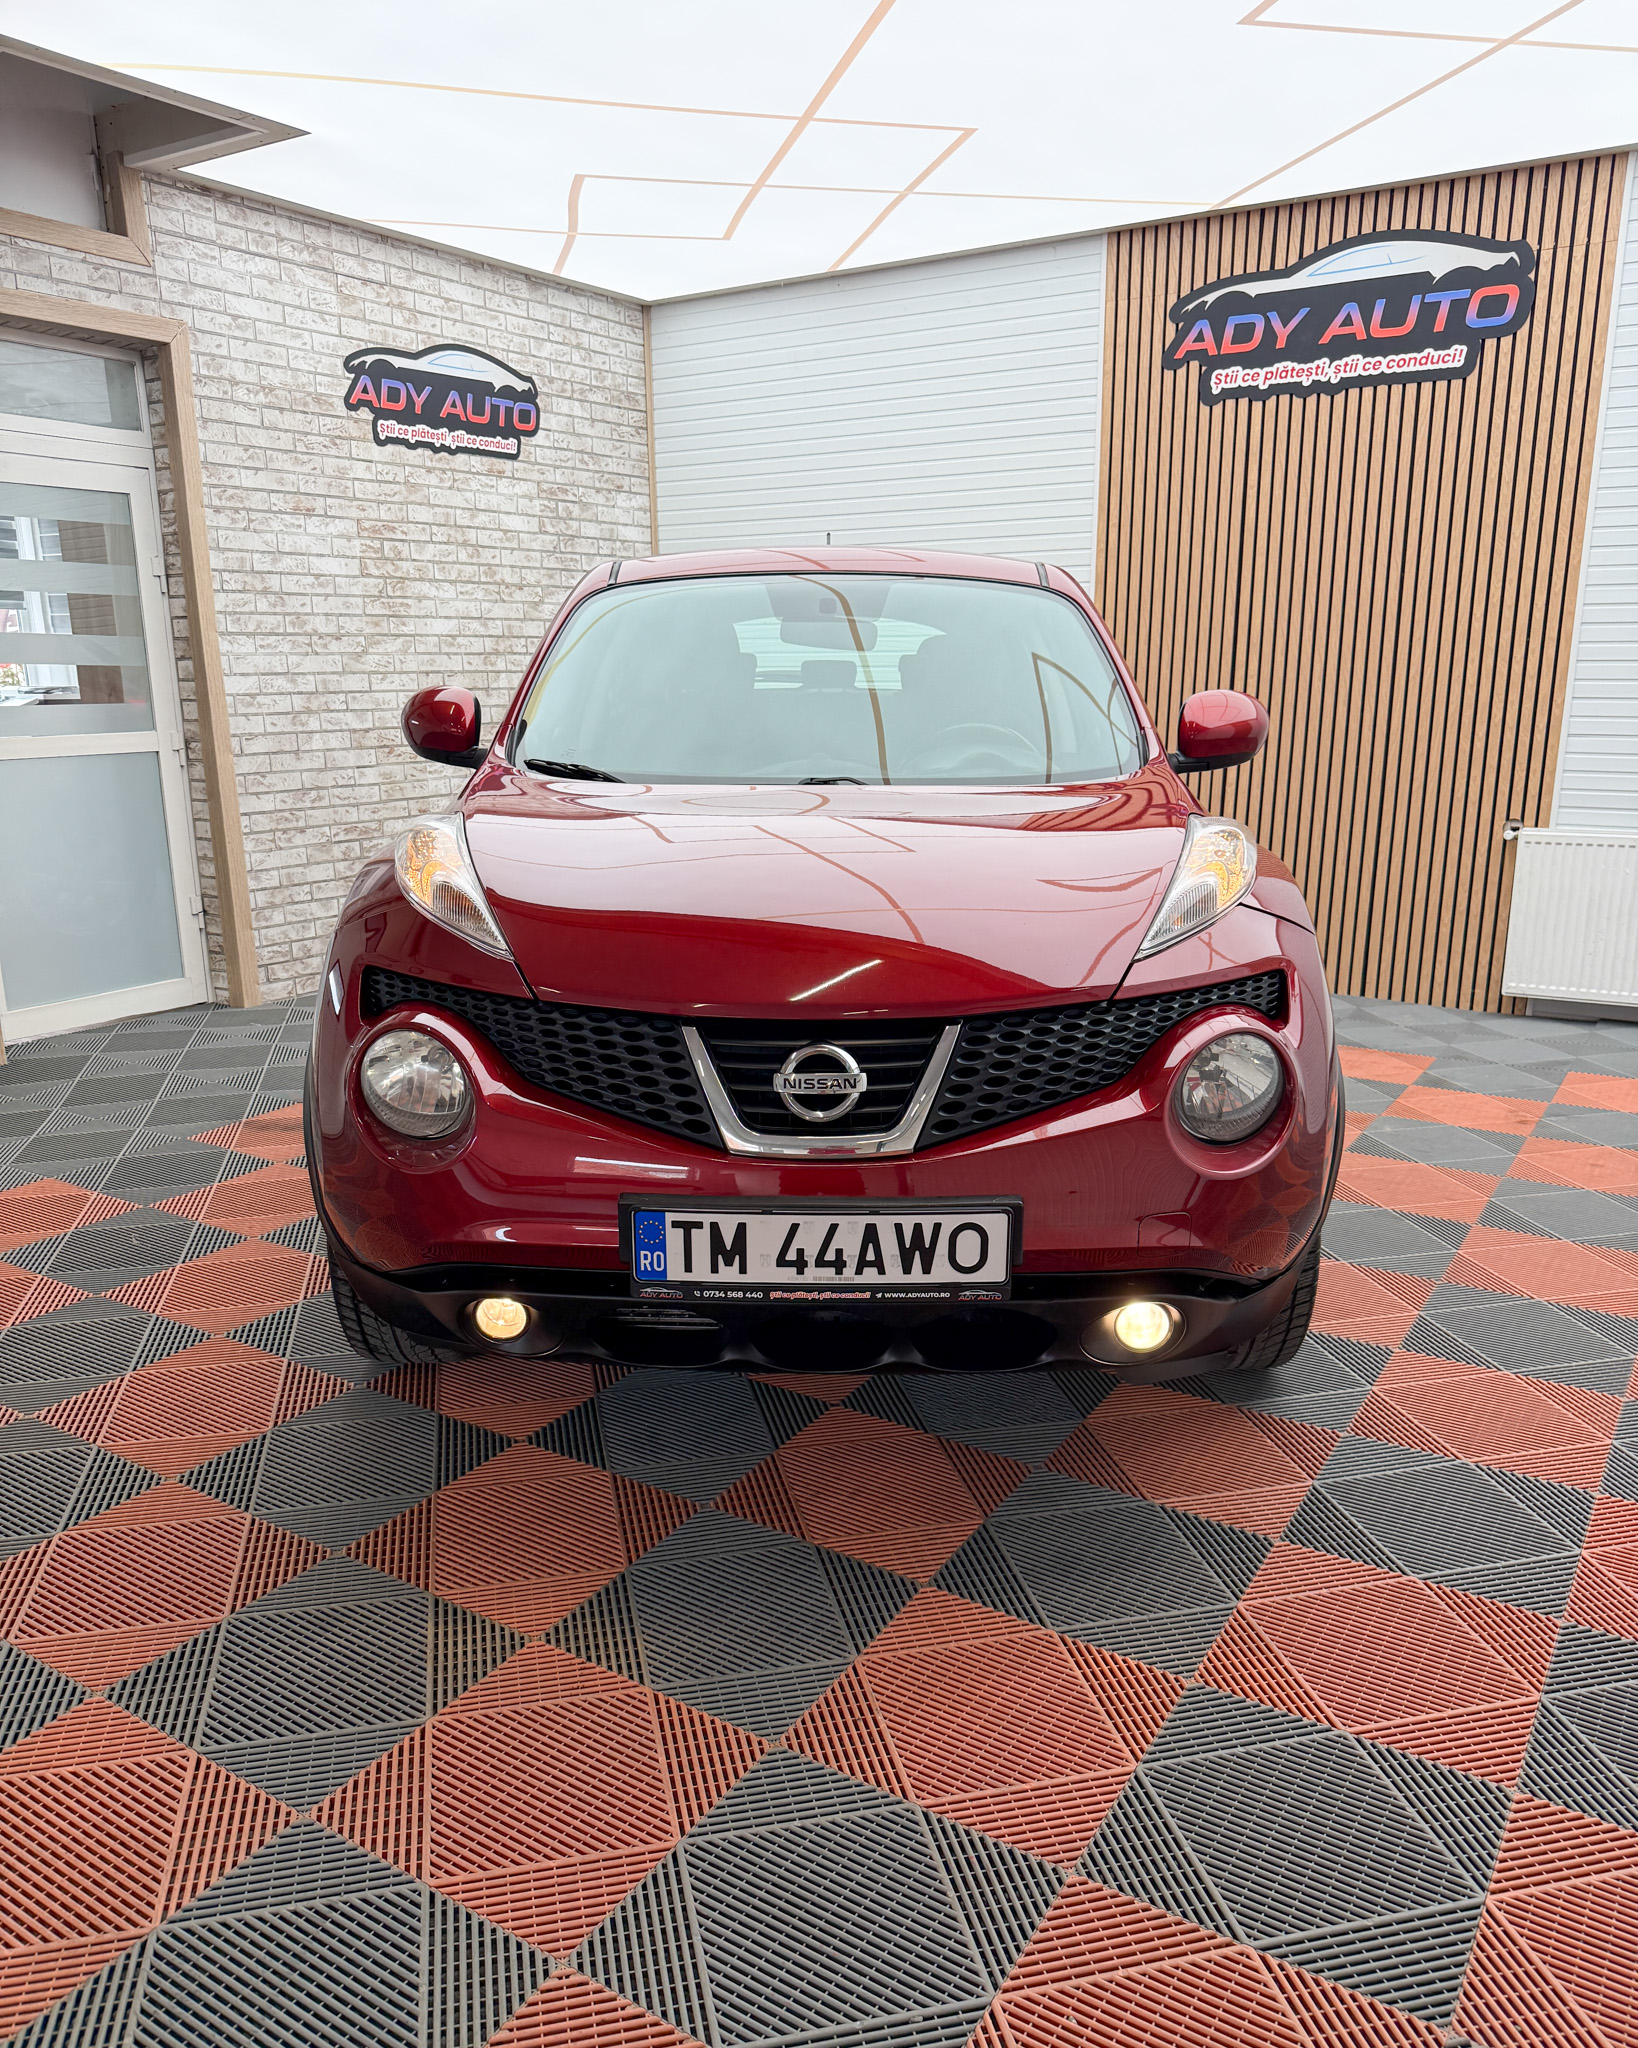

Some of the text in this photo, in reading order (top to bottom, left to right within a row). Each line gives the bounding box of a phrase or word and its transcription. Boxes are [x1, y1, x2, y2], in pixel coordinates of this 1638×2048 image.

[1173, 284, 1520, 360] ADY AUTO
[1213, 348, 1464, 390] Știi ce plătești, știi ce conduci!
[349, 375, 537, 431] ADY AUTO
[379, 423, 396, 437] Știi
[397, 427, 409, 436] ce
[466, 436, 477, 446] ce
[479, 439, 516, 452] conduci!
[783, 1077, 857, 1090] NISSAN
[640, 1250, 665, 1272] RO
[671, 1220, 748, 1275] TM
[703, 1290, 725, 1298] 0734
[745, 1291, 763, 1299] 440
